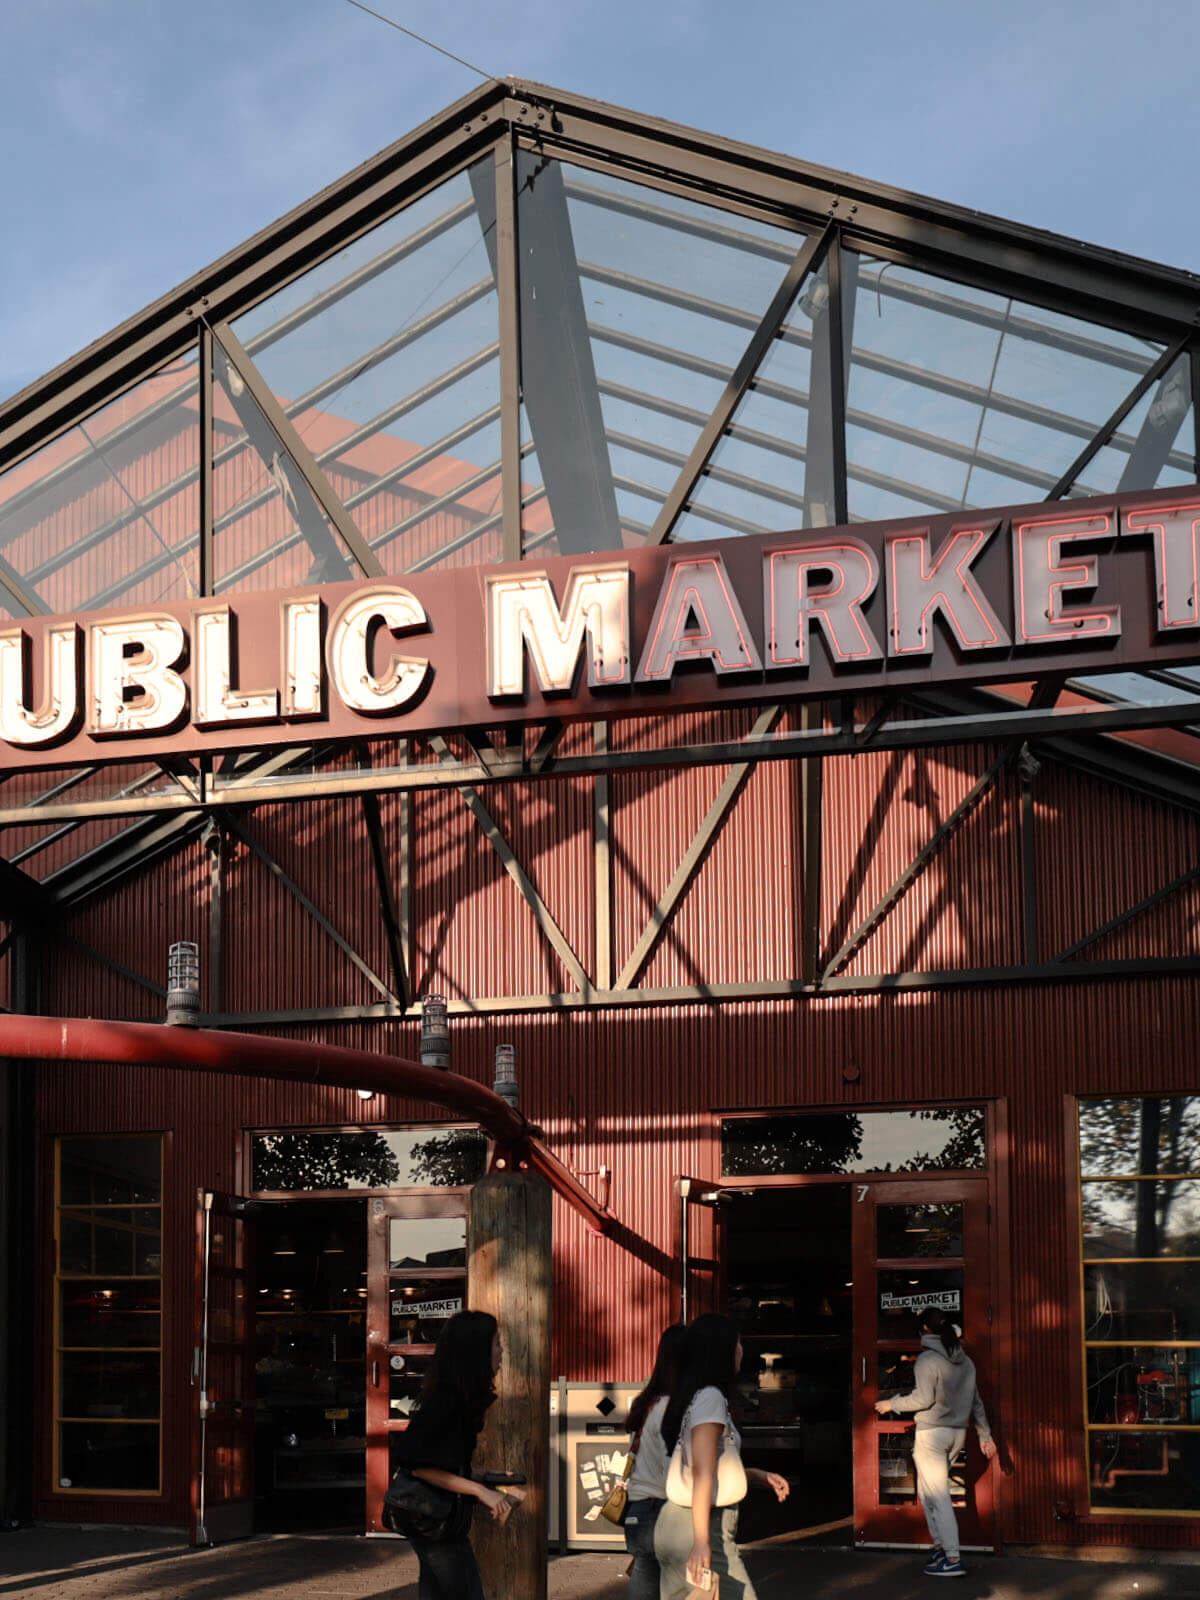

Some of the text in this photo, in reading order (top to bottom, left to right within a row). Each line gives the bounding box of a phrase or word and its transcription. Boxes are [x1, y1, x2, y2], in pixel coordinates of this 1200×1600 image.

[485, 496, 1200, 699] MARKET
[856, 1185, 869, 1202] 7
[373, 1199, 384, 1214] 6
[393, 1299, 460, 1313] PUBLIC MARKET
[882, 1292, 958, 1307] PUBLIC MARKET
